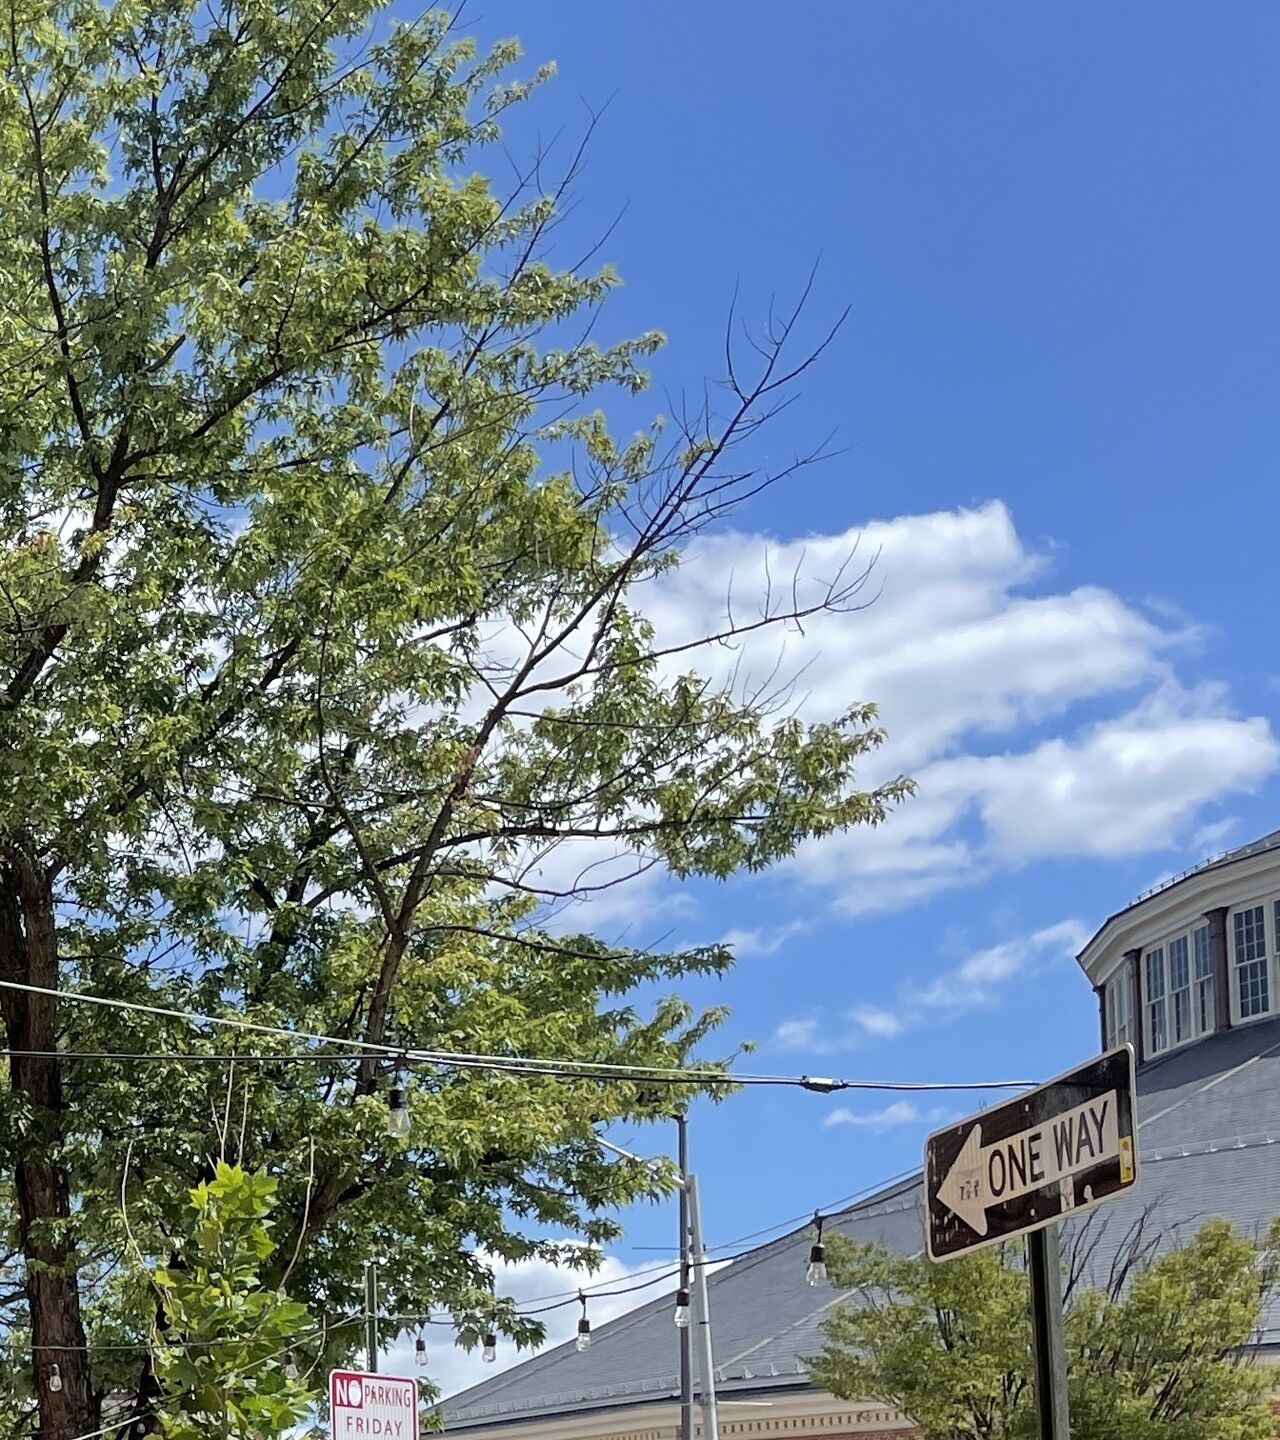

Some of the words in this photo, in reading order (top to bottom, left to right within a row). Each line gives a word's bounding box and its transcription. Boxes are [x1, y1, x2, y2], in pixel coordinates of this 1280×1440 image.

[989, 1131, 1045, 1197] ONE
[1053, 1100, 1108, 1172] WAY
[335, 1378, 362, 1407] NO
[364, 1384, 411, 1408] PARKING
[346, 1415, 403, 1437] FRIDAY
